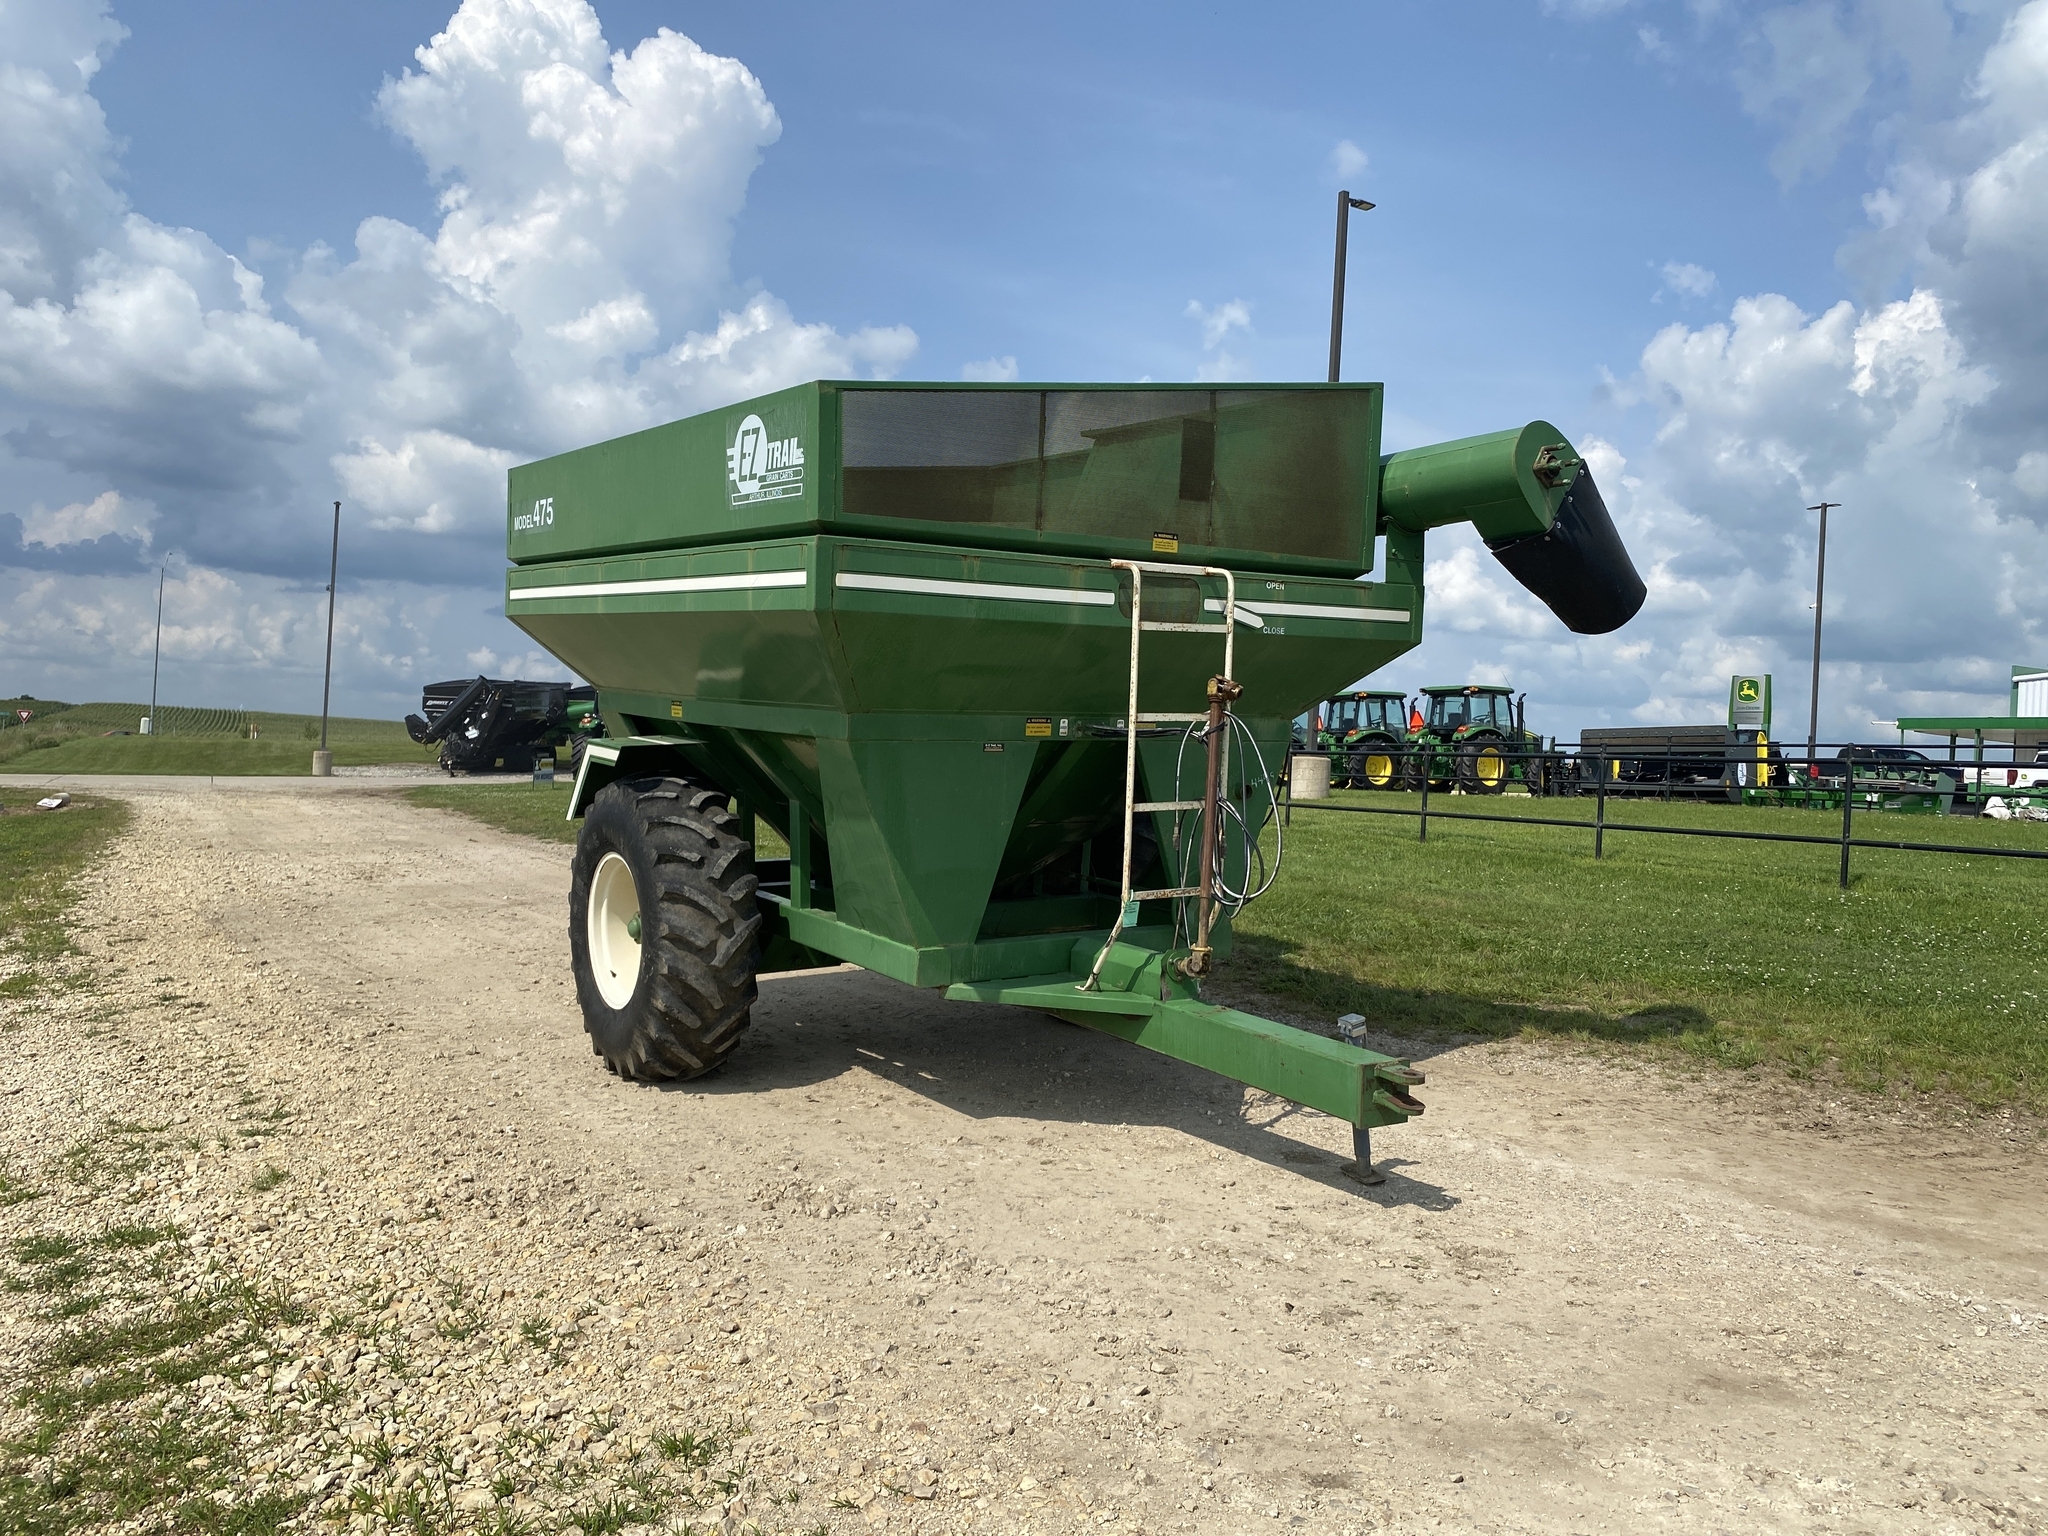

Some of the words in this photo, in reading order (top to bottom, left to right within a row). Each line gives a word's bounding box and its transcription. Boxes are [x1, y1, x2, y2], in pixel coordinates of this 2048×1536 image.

[767, 437, 804, 470] TRAIL
[766, 473, 779, 482] GRAIN
[780, 470, 794, 480] CARTS
[514, 514, 534, 531] MODEL
[533, 497, 554, 527] 475
[1266, 581, 1285, 590] OPEN
[1262, 626, 1285, 635] CLOSE
